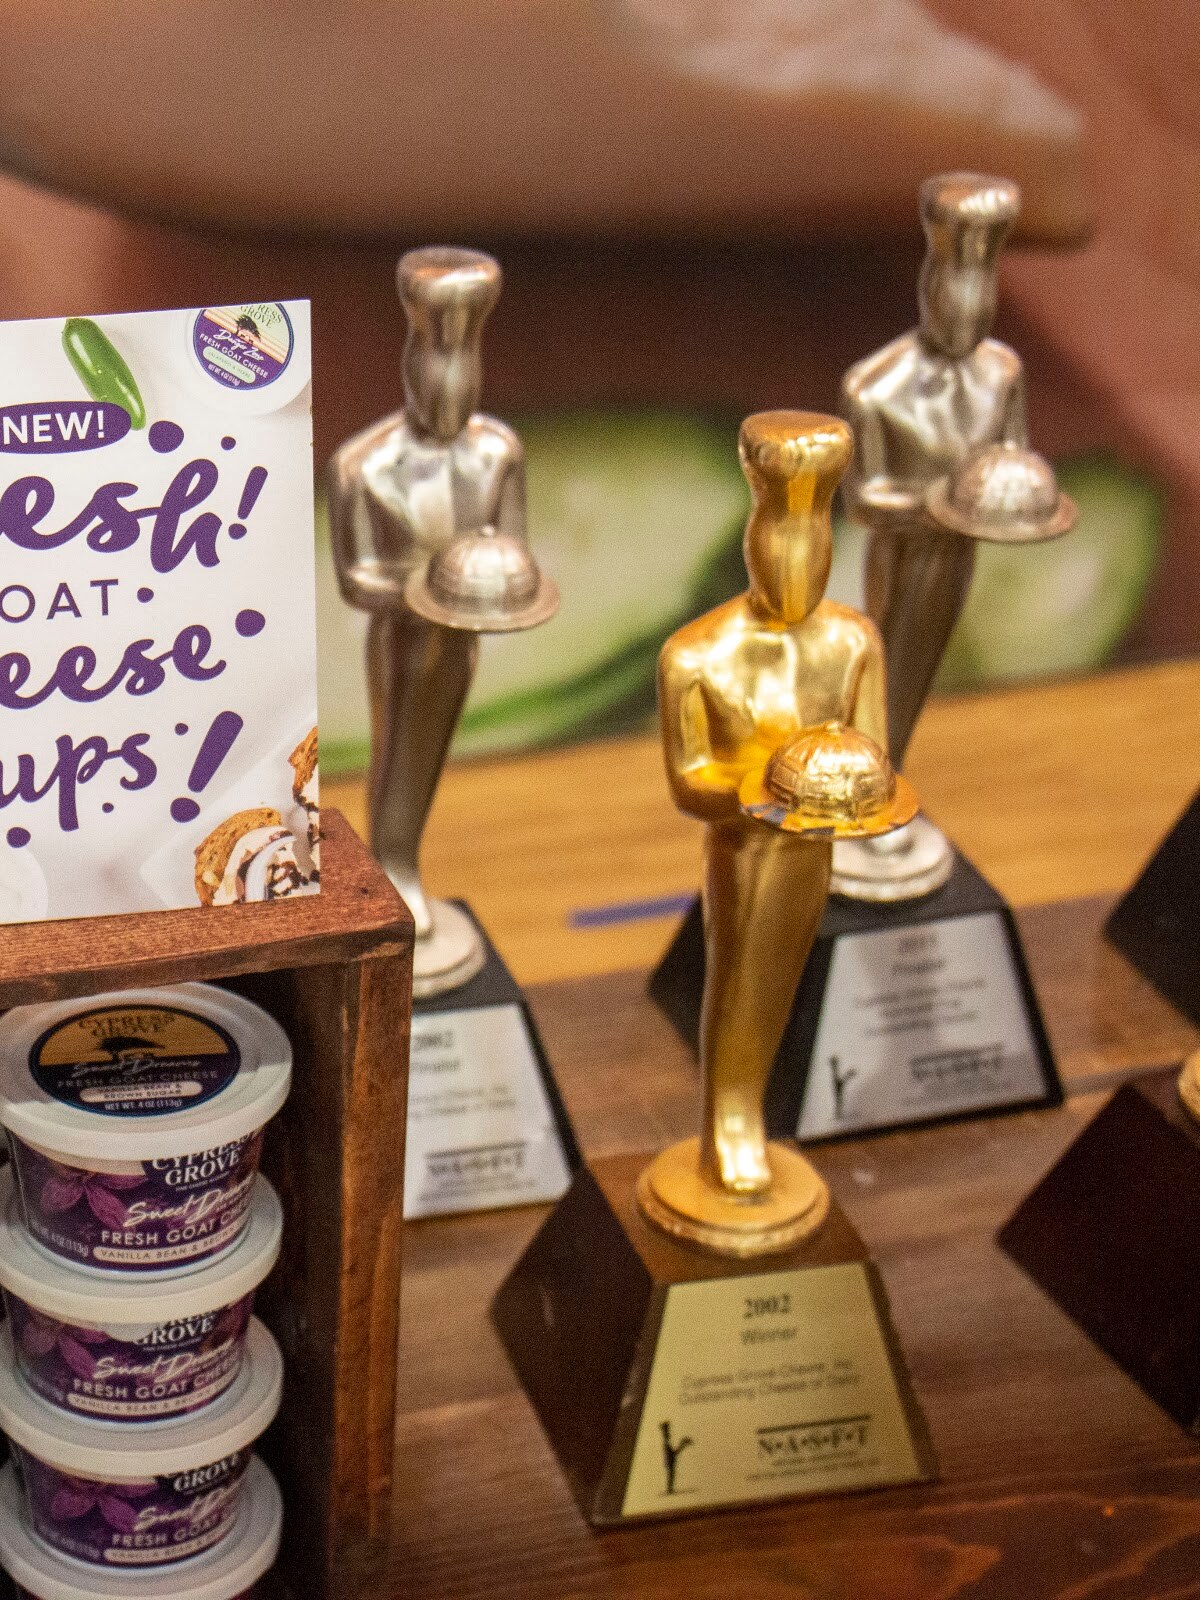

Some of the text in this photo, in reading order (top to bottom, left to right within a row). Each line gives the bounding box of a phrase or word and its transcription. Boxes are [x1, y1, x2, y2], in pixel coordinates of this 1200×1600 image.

[241, 305, 273, 328] GROVE
[200, 333, 221, 349] FRESH
[221, 346, 243, 362] GOAT
[242, 360, 269, 379] CHEESE
[2, 410, 106, 446] NEW!
[78, 1014, 176, 1030] CYPRESS
[57, 1070, 219, 1089] FRESH GOAT CHEESE
[104, 1089, 182, 1099] BROWN SUGAR
[104, 1103, 120, 1111] NET
[164, 1149, 240, 1186] GROVE
[101, 1220, 218, 1246] FRESH GOAT
[101, 1247, 151, 1260] VANILLA
[156, 1247, 187, 1259] BEAN
[72, 1378, 128, 1399] FRESH
[135, 1381, 188, 1399] GOAT
[126, 1402, 158, 1412] BEAN
[112, 1530, 168, 1548] FRESH
